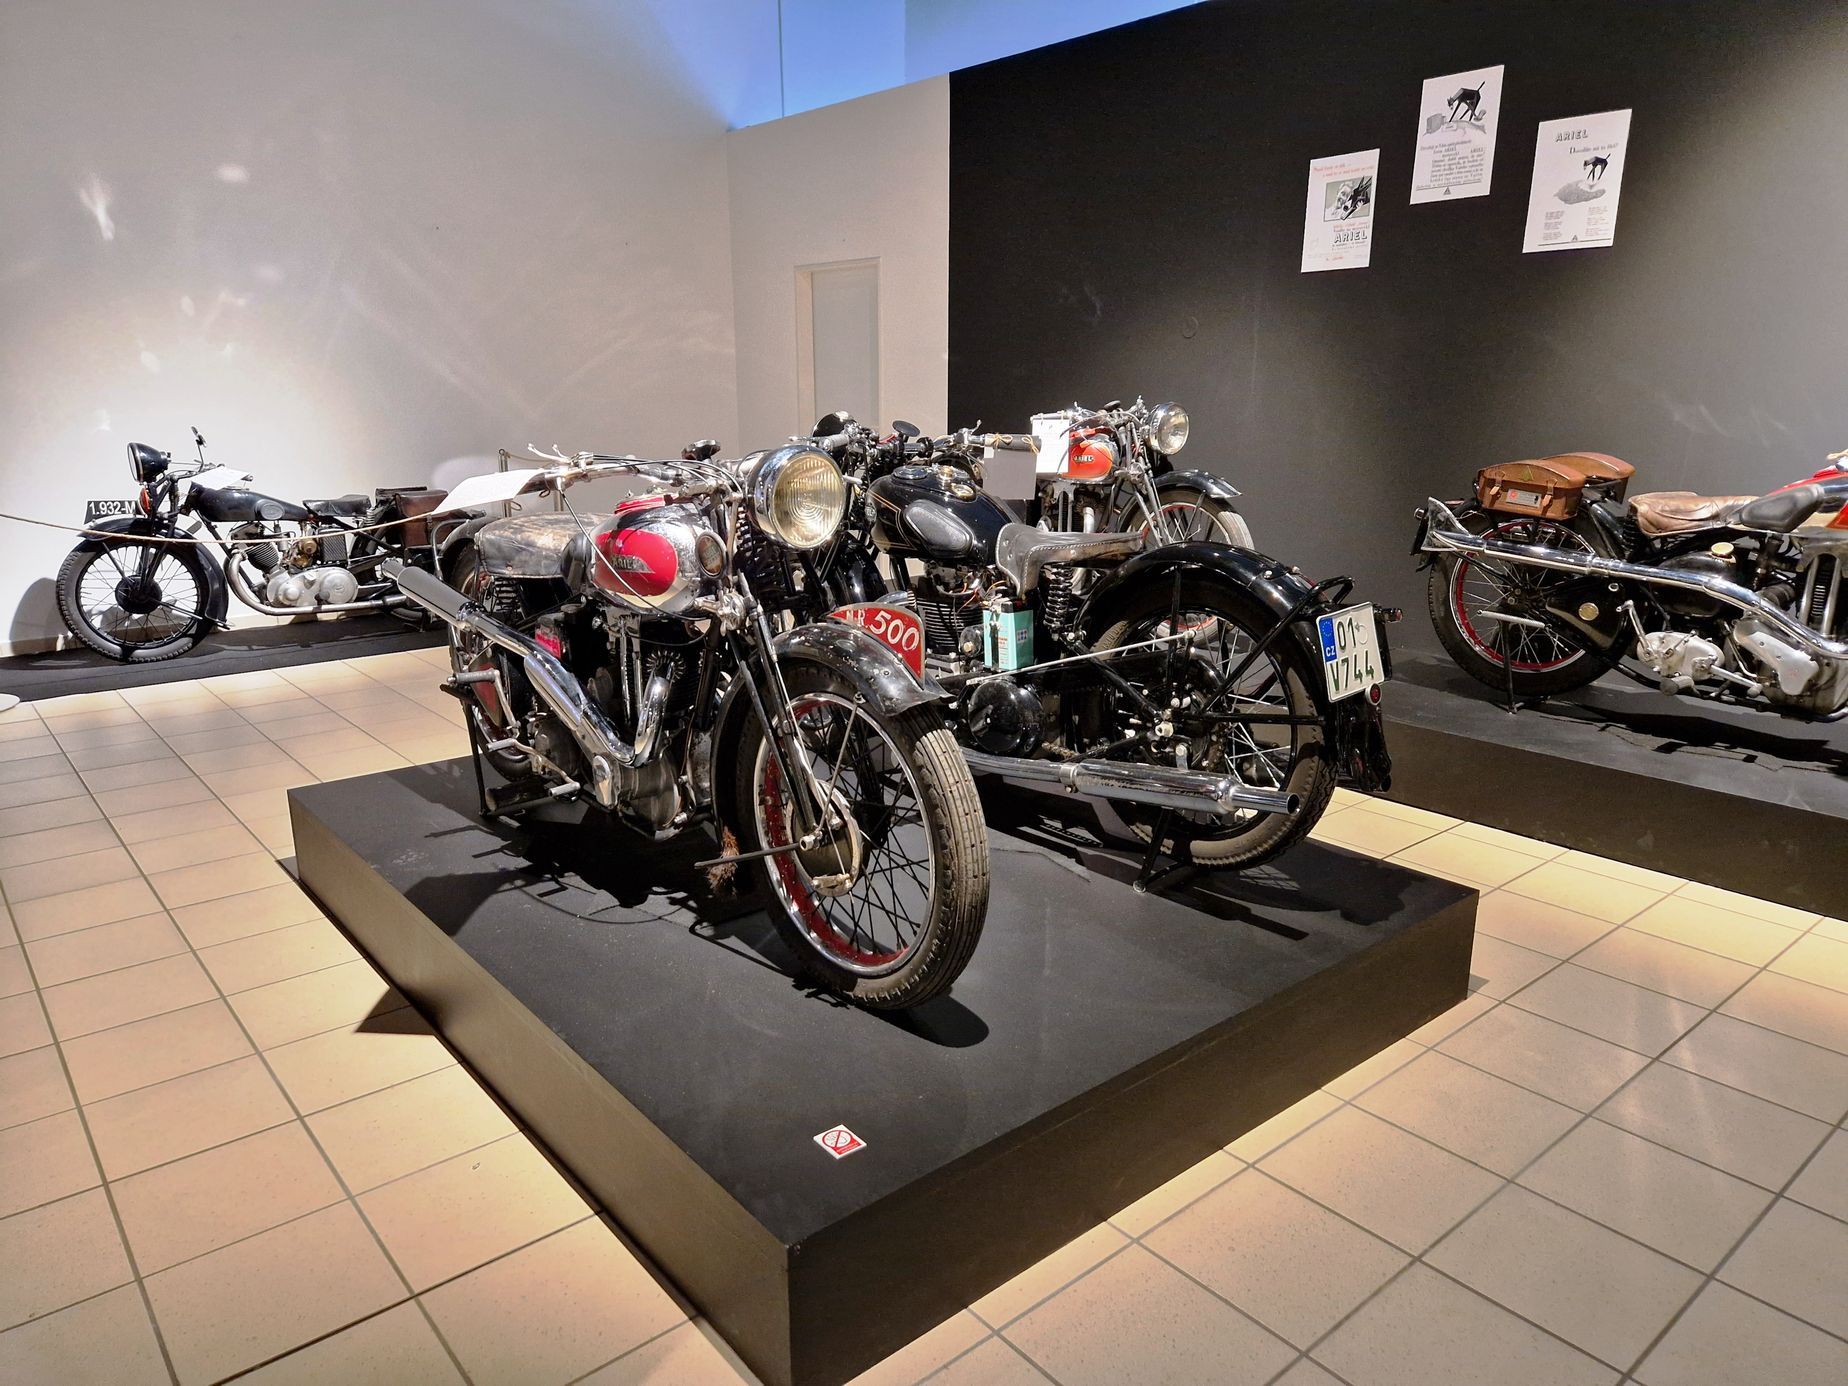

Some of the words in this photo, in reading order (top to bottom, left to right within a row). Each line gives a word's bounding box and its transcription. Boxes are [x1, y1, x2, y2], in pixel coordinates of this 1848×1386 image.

[1555, 129, 1588, 142] ARIEL
[1334, 230, 1368, 244] ARIEL
[869, 610, 920, 651] 500
[1337, 616, 1356, 650] 01
[1325, 646, 1336, 657] CZ
[1329, 650, 1375, 692] V744
